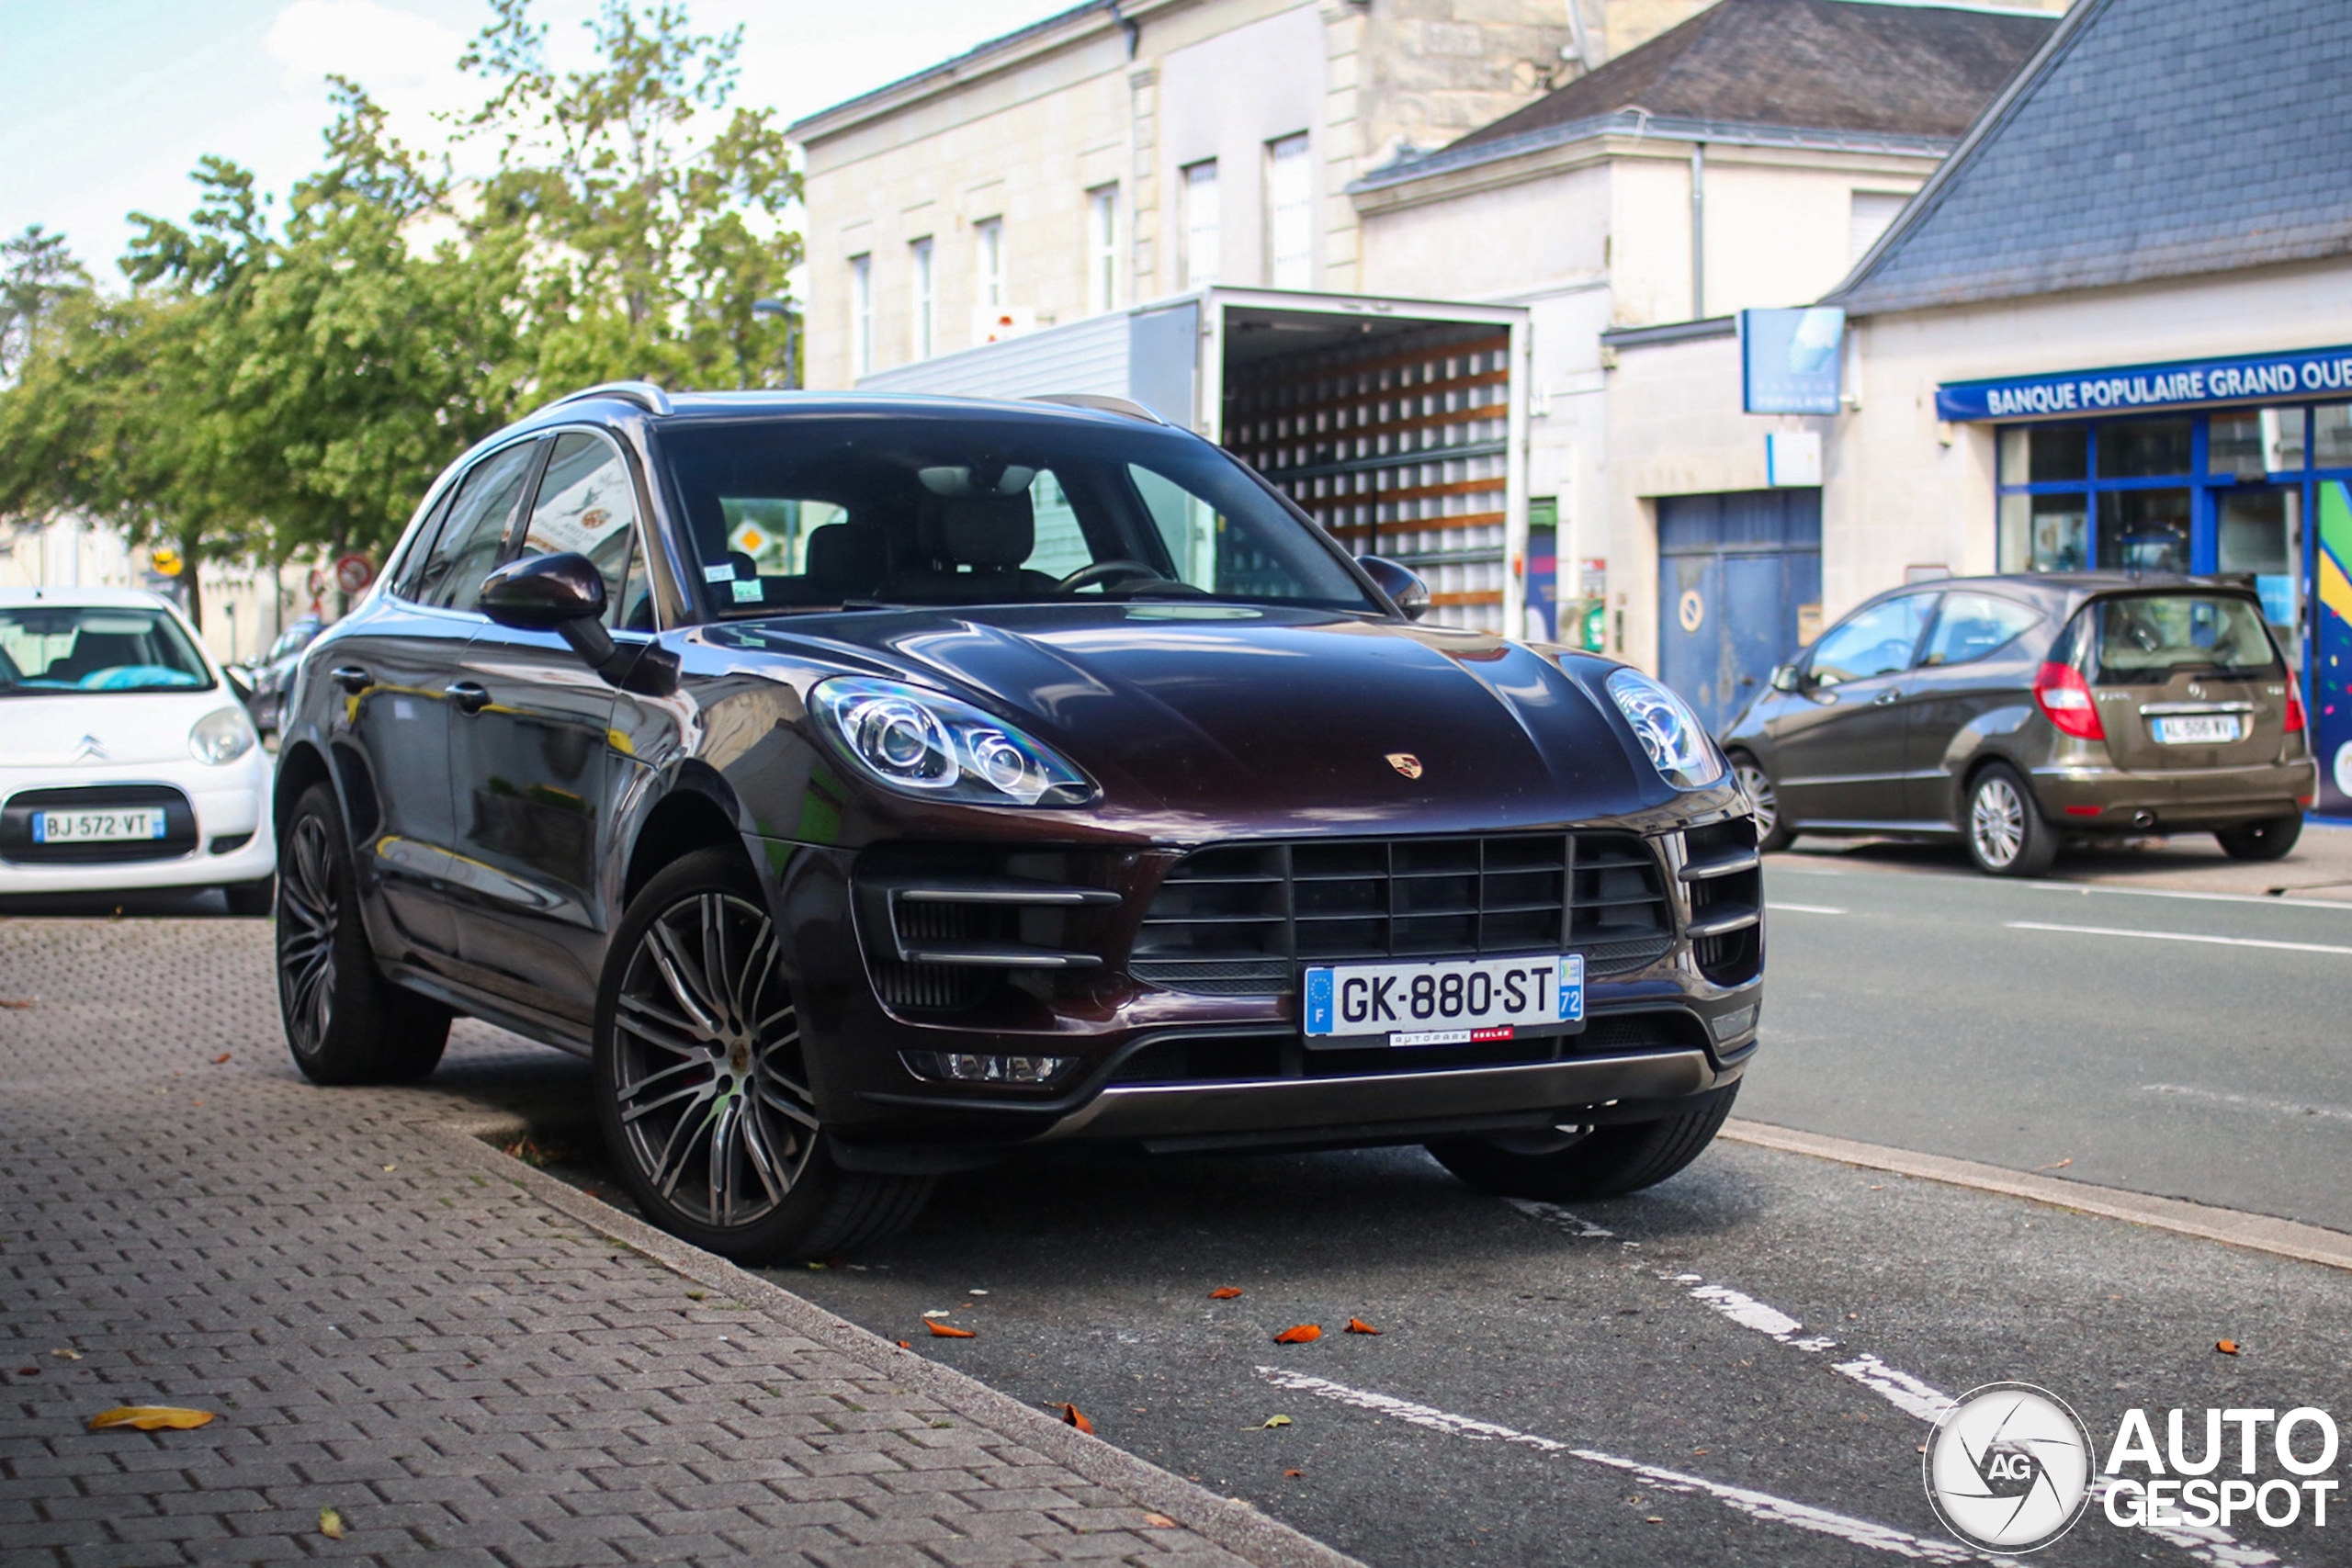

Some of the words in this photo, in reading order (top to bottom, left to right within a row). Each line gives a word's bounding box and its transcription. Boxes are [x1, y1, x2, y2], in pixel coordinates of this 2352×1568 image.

[1986, 382, 2078, 415] BANQUE
[2079, 371, 2205, 408] POPULAIRE
[2208, 363, 2297, 398] GRAND
[1341, 966, 1554, 1023] GK-880-ST
[1560, 990, 1580, 1014] 72
[1315, 1008, 1325, 1023] F
[1395, 1033, 1468, 1043] AUTOPARK
